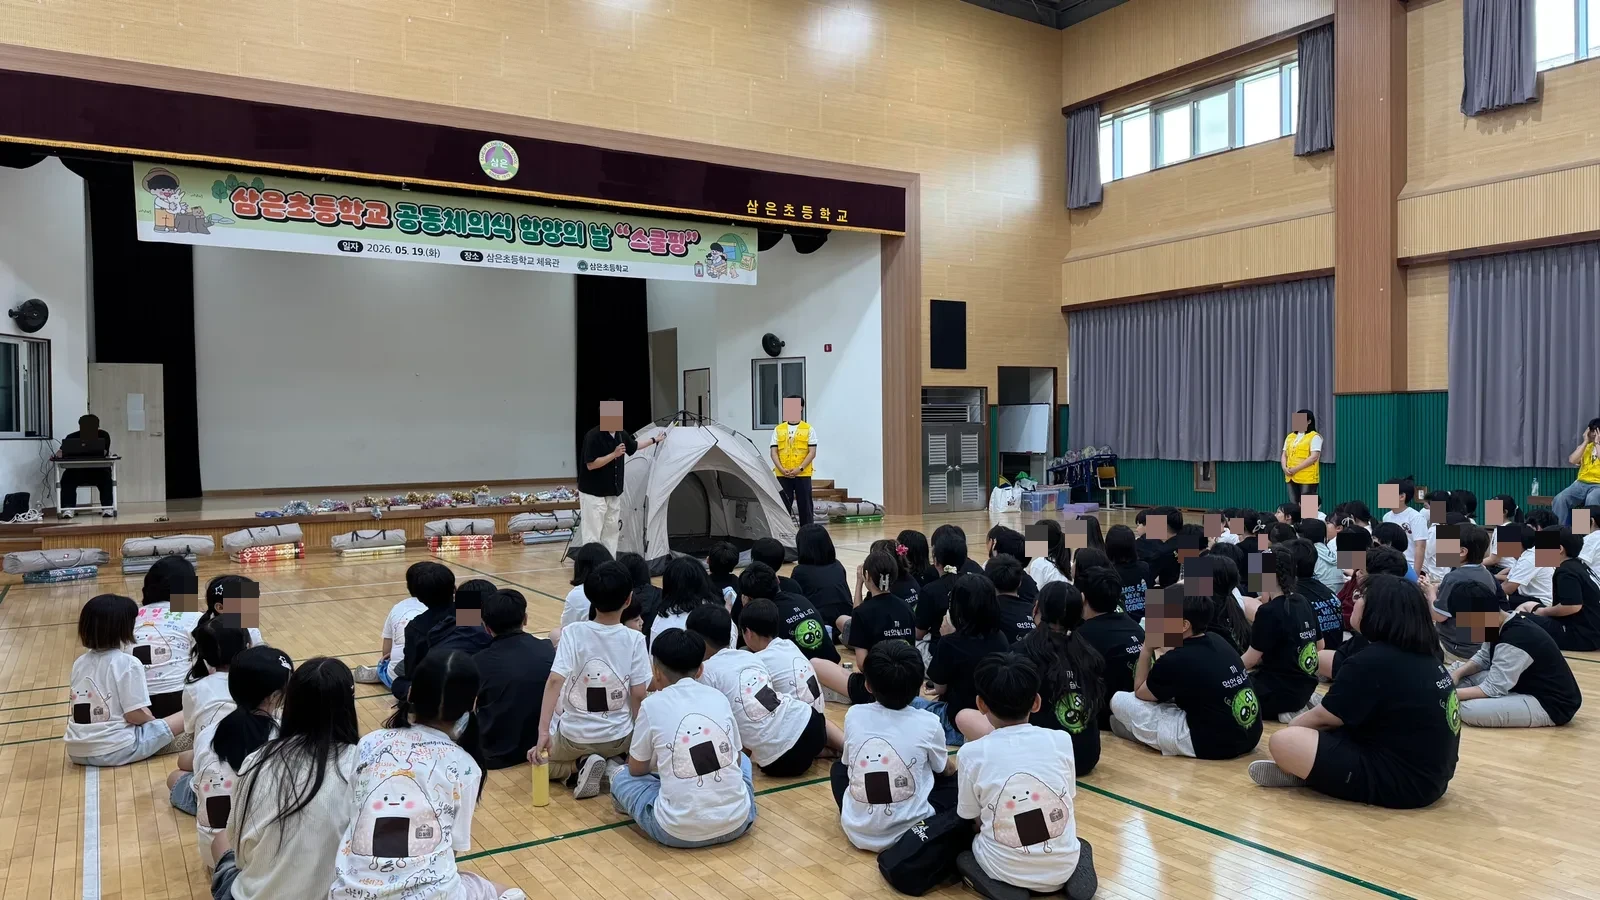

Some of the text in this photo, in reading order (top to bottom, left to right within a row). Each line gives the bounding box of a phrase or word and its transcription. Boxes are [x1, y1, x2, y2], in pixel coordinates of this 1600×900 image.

[490, 157, 508, 169] 삼은
[746, 199, 849, 223] 삼은초등학교
[230, 187, 393, 229] 삼은초등학교
[394, 202, 516, 243] 공동체의식
[517, 215, 587, 248] 함양의
[588, 222, 614, 251] 날
[342, 240, 360, 252] 일자
[367, 243, 392, 254] 2026.
[464, 251, 560, 268] 장소 삼은초등학교 체육관
[589, 262, 629, 273] 삼은초등학교
